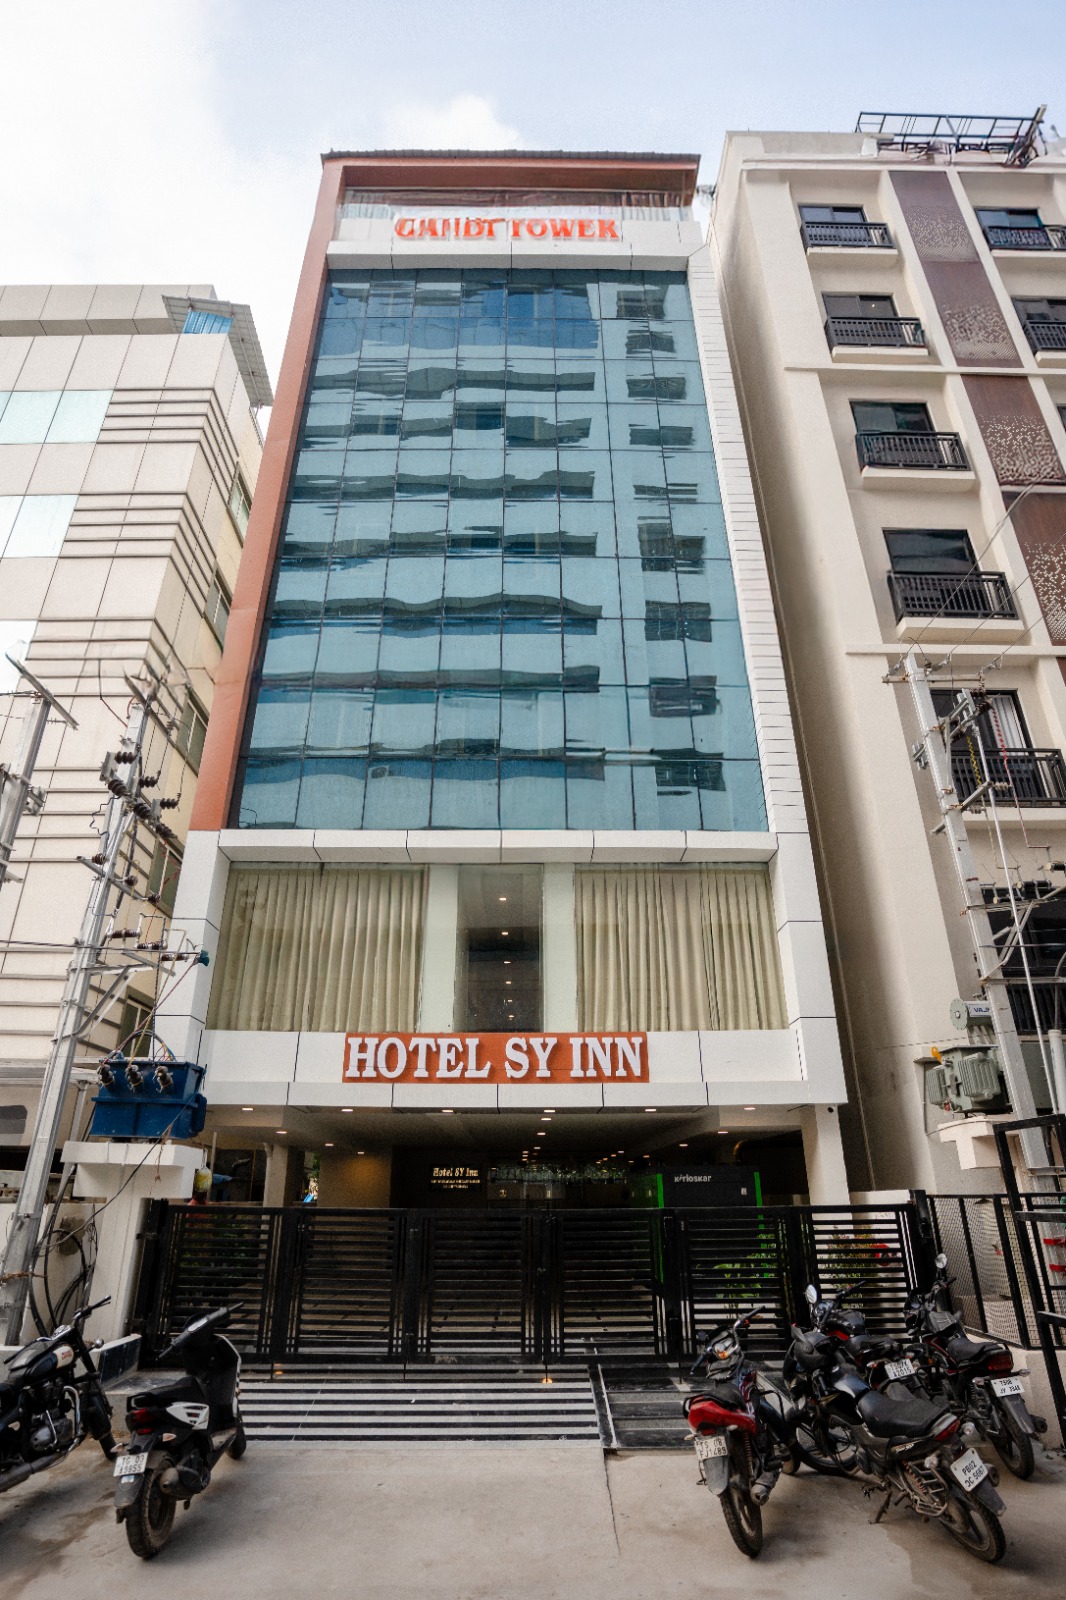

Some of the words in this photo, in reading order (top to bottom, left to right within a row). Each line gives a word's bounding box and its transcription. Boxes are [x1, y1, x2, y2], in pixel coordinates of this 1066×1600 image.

[344, 1036, 492, 1079] HOTEL
[504, 1036, 558, 1078] SY
[569, 1036, 643, 1078] INN
[432, 1167, 453, 1177] Hotel
[465, 1167, 479, 1177] Inn
[961, 1460, 978, 1476] PB02
